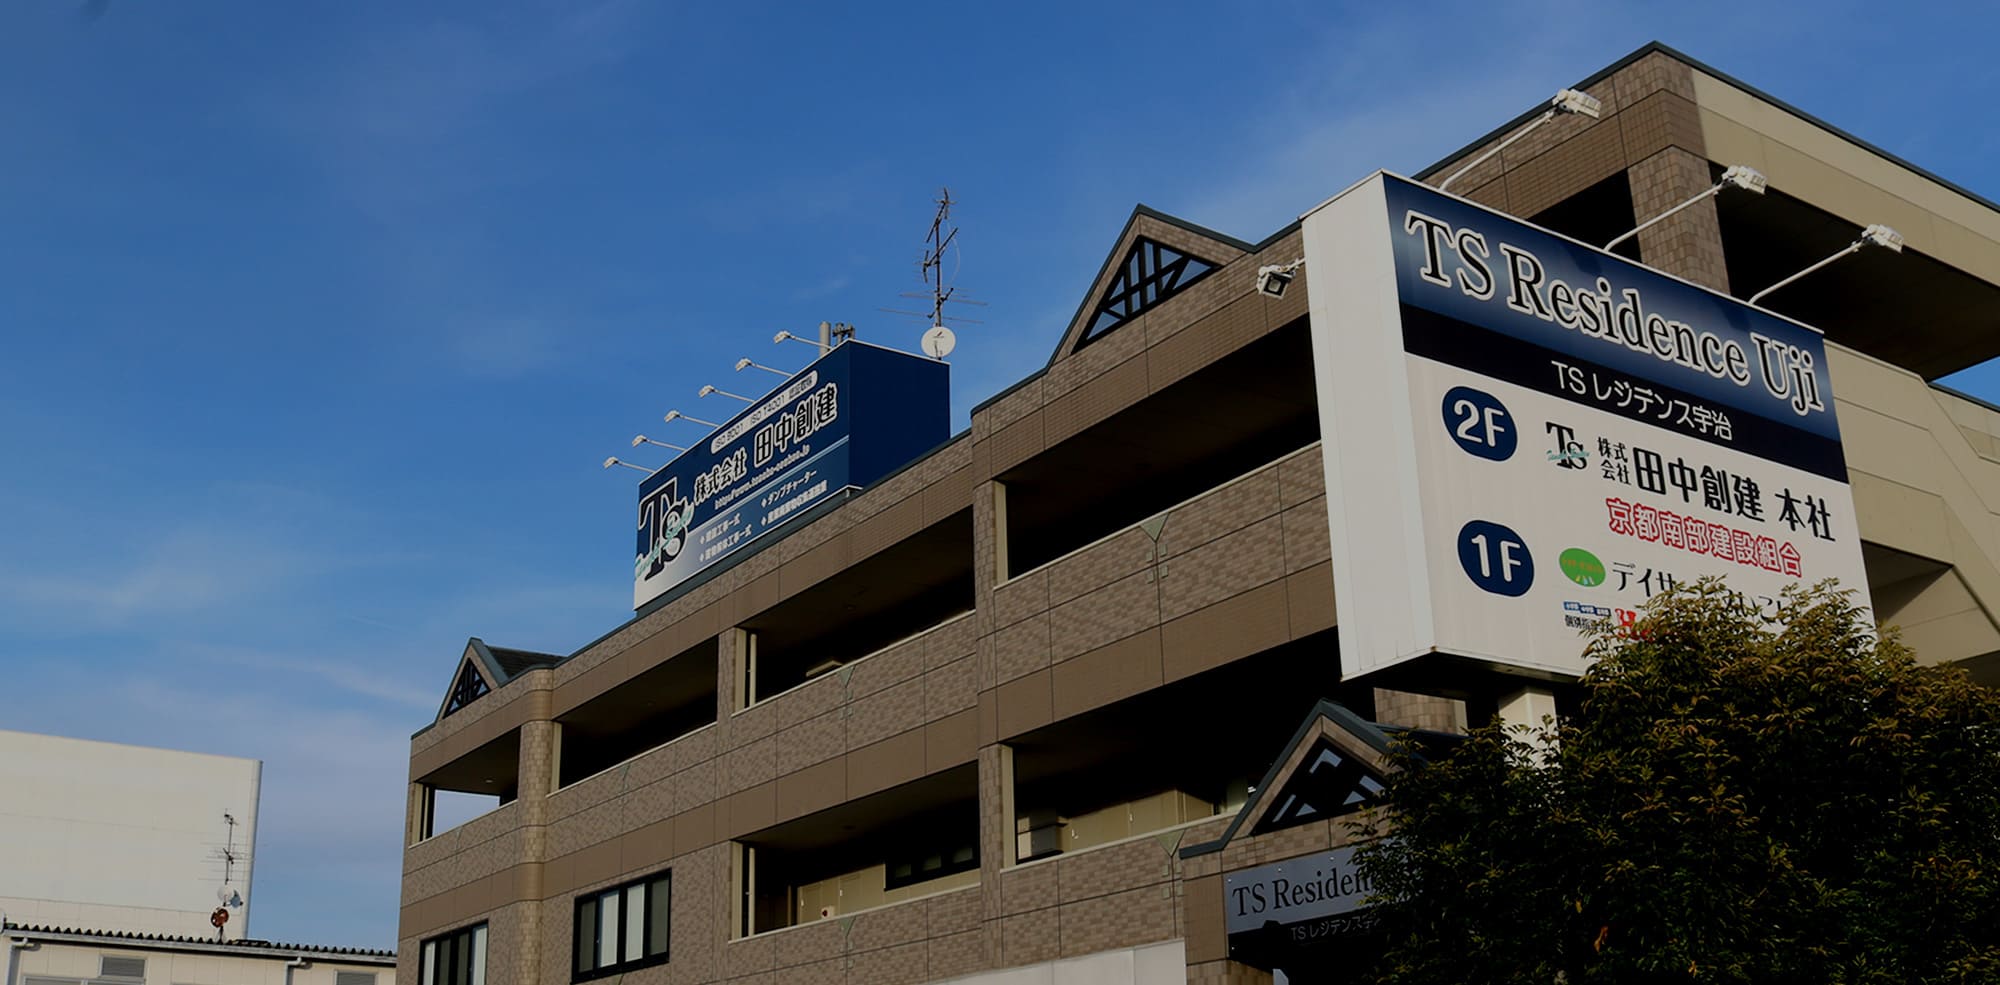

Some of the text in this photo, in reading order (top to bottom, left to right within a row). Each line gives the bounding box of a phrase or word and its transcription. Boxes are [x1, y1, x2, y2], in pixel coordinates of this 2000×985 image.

[1406, 211, 1824, 415] TS Residence Uji
[1452, 399, 1506, 448] 2F
[1551, 360, 1733, 441] TS レジデンス宇治
[695, 448, 746, 504] 株式会社
[754, 383, 837, 467] 田中創建
[1634, 446, 1836, 542] 田中創建 本社
[1470, 533, 1522, 583] 1F
[1606, 497, 1802, 578] 京都南部建設組合
[1233, 867, 1376, 916] TS Residen
